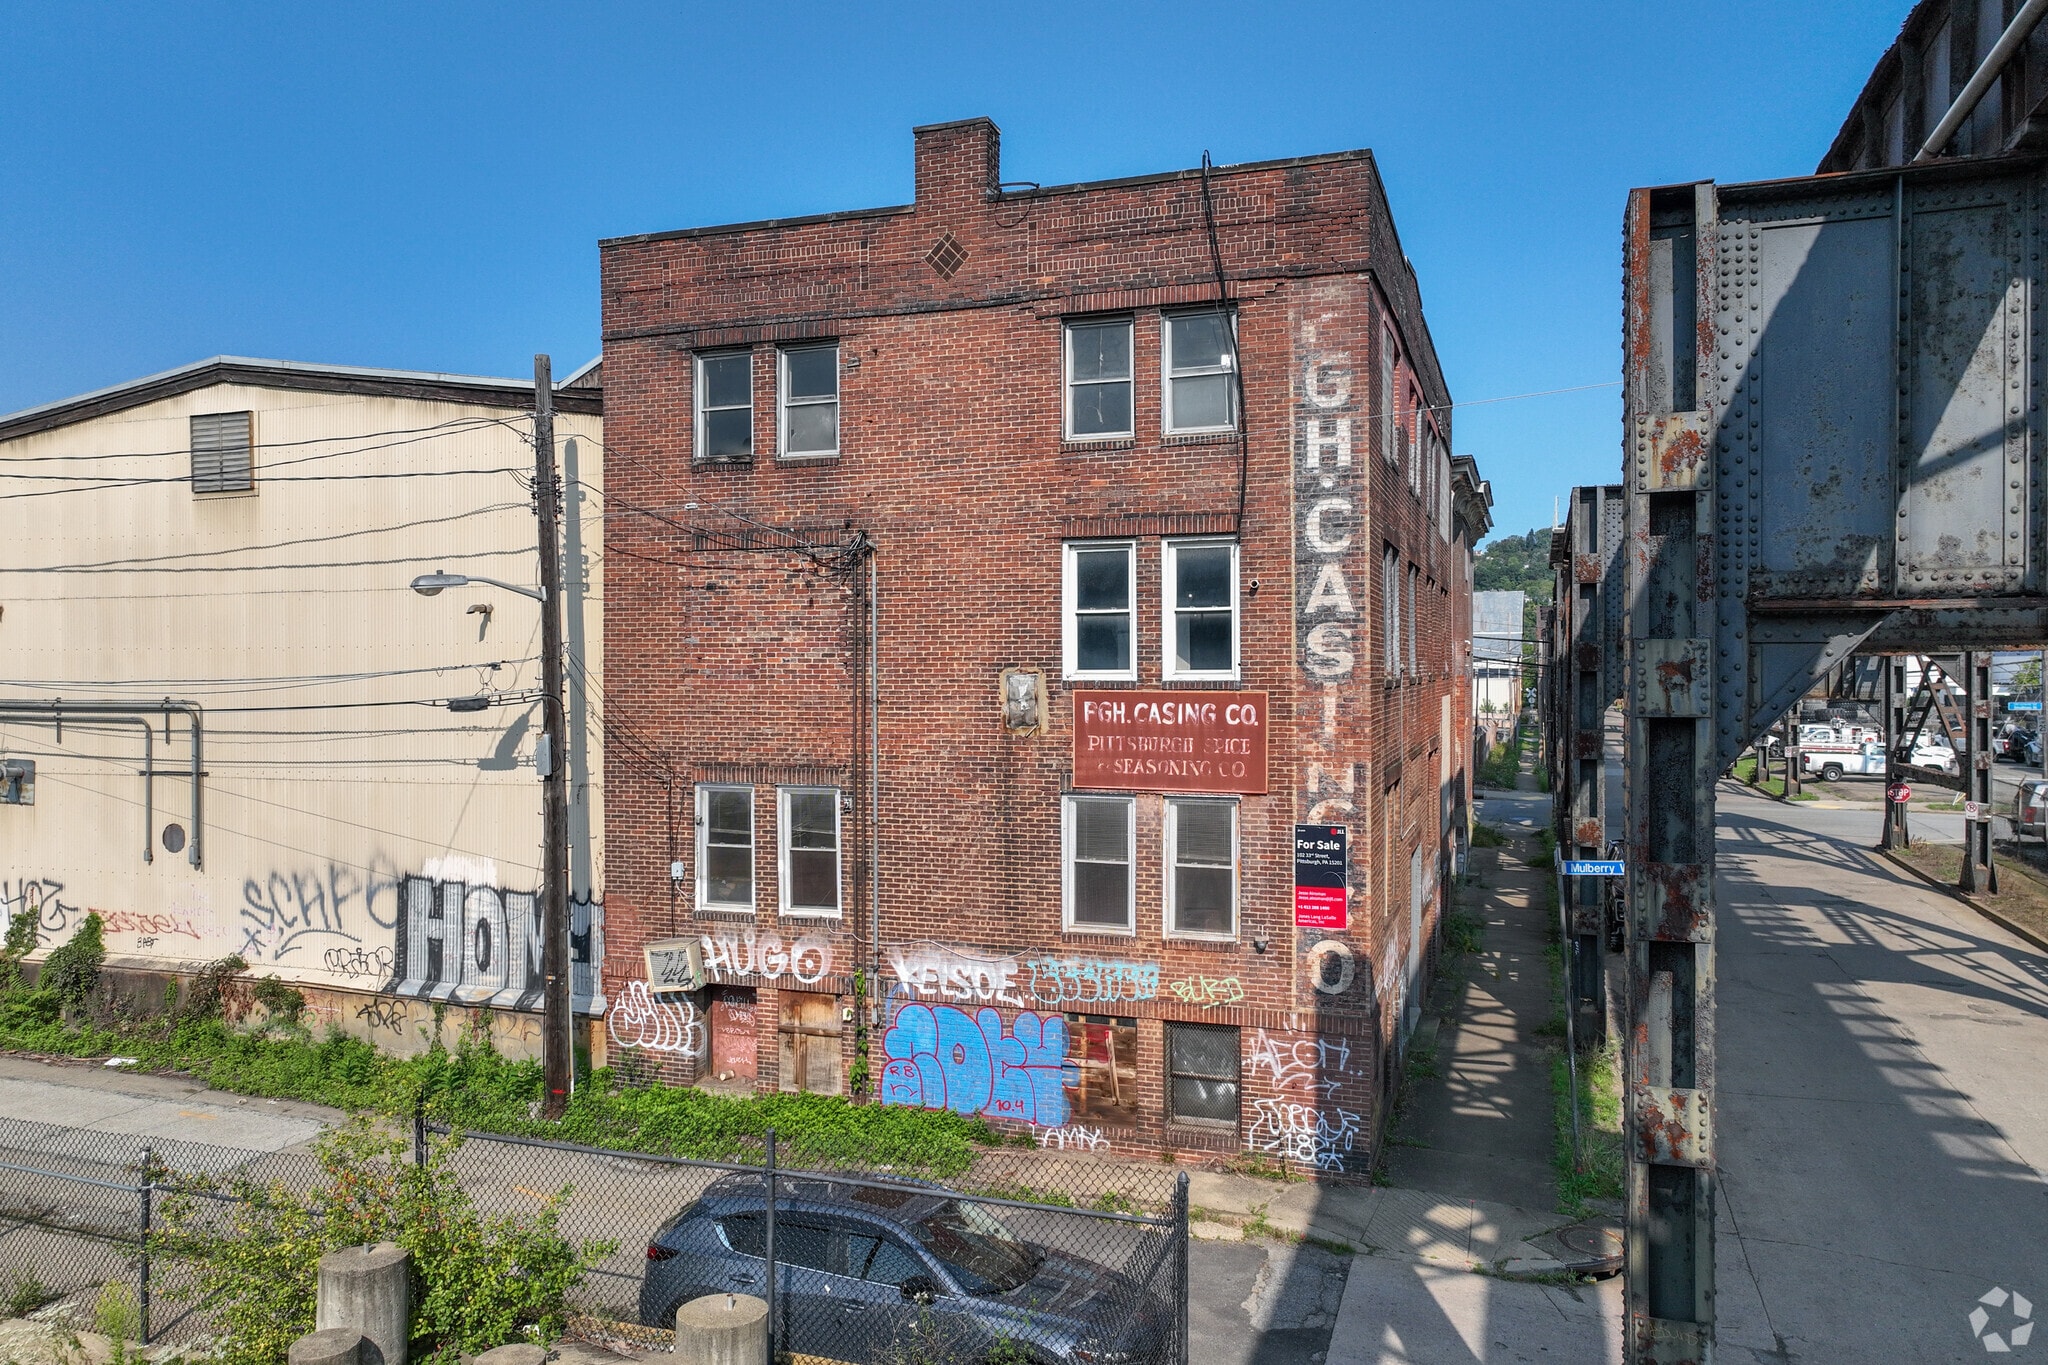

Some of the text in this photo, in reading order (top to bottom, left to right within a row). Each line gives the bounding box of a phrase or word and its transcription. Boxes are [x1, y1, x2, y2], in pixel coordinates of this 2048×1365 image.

[1083, 701, 1259, 727] PGH. CASING CO.
[1087, 735, 1251, 755] PITTSBURGH SPICE
[1114, 758, 1212, 777] SEASONING
[1889, 788, 1909, 797] STOP
[1297, 839, 1341, 851] For Sale
[1296, 858, 1322, 866] Pittsburgh,
[1570, 863, 1615, 875] Mulberry
[701, 932, 832, 983] HUGO
